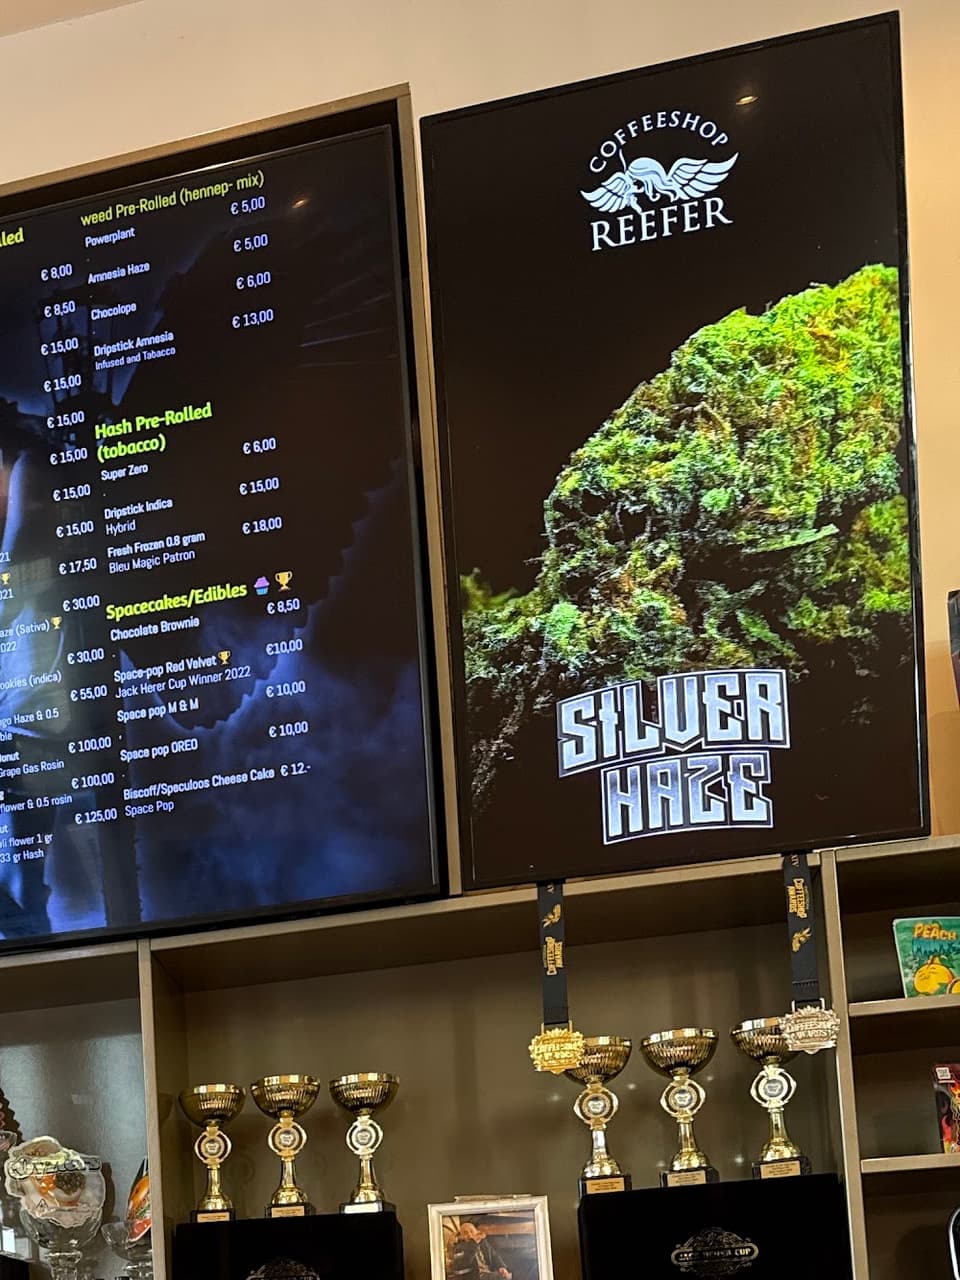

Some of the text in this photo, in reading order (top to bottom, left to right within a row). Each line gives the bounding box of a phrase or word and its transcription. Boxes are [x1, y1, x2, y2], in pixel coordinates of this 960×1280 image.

[589, 110, 730, 174] COFFEESHOP
[81, 207, 112, 226] weed
[116, 191, 176, 218] Pre-Rolled
[237, 170, 265, 190] mix)
[242, 197, 265, 213] 5,00
[591, 197, 733, 251] REEFER
[85, 227, 135, 247] Powerplant
[244, 234, 268, 250] 5,00
[88, 263, 149, 284] Amnesia Haze
[94, 331, 174, 356] Dripstick Amnesia
[95, 402, 212, 439] Hash Pre-Rolled
[97, 434, 166, 463] (tobacco)
[108, 544, 132, 557] Fresh
[134, 540, 164, 554] Frozen
[182, 533, 205, 546] gram
[109, 550, 195, 573] Bleu Magic Patron
[106, 583, 247, 622] Spacecakes/Edibles
[16, 620, 50, 636] (Sativa)
[111, 617, 199, 641] Chocolate Brownie
[114, 655, 217, 684] Space-pop Red Velvet
[116, 666, 251, 698] Jack Herer Cup Winner 2022
[556, 669, 790, 778] SILVER
[212, 772, 248, 787] Cheese
[250, 767, 274, 781] Cake
[601, 750, 774, 845] HAZE
[914, 923, 957, 941] PEACH
